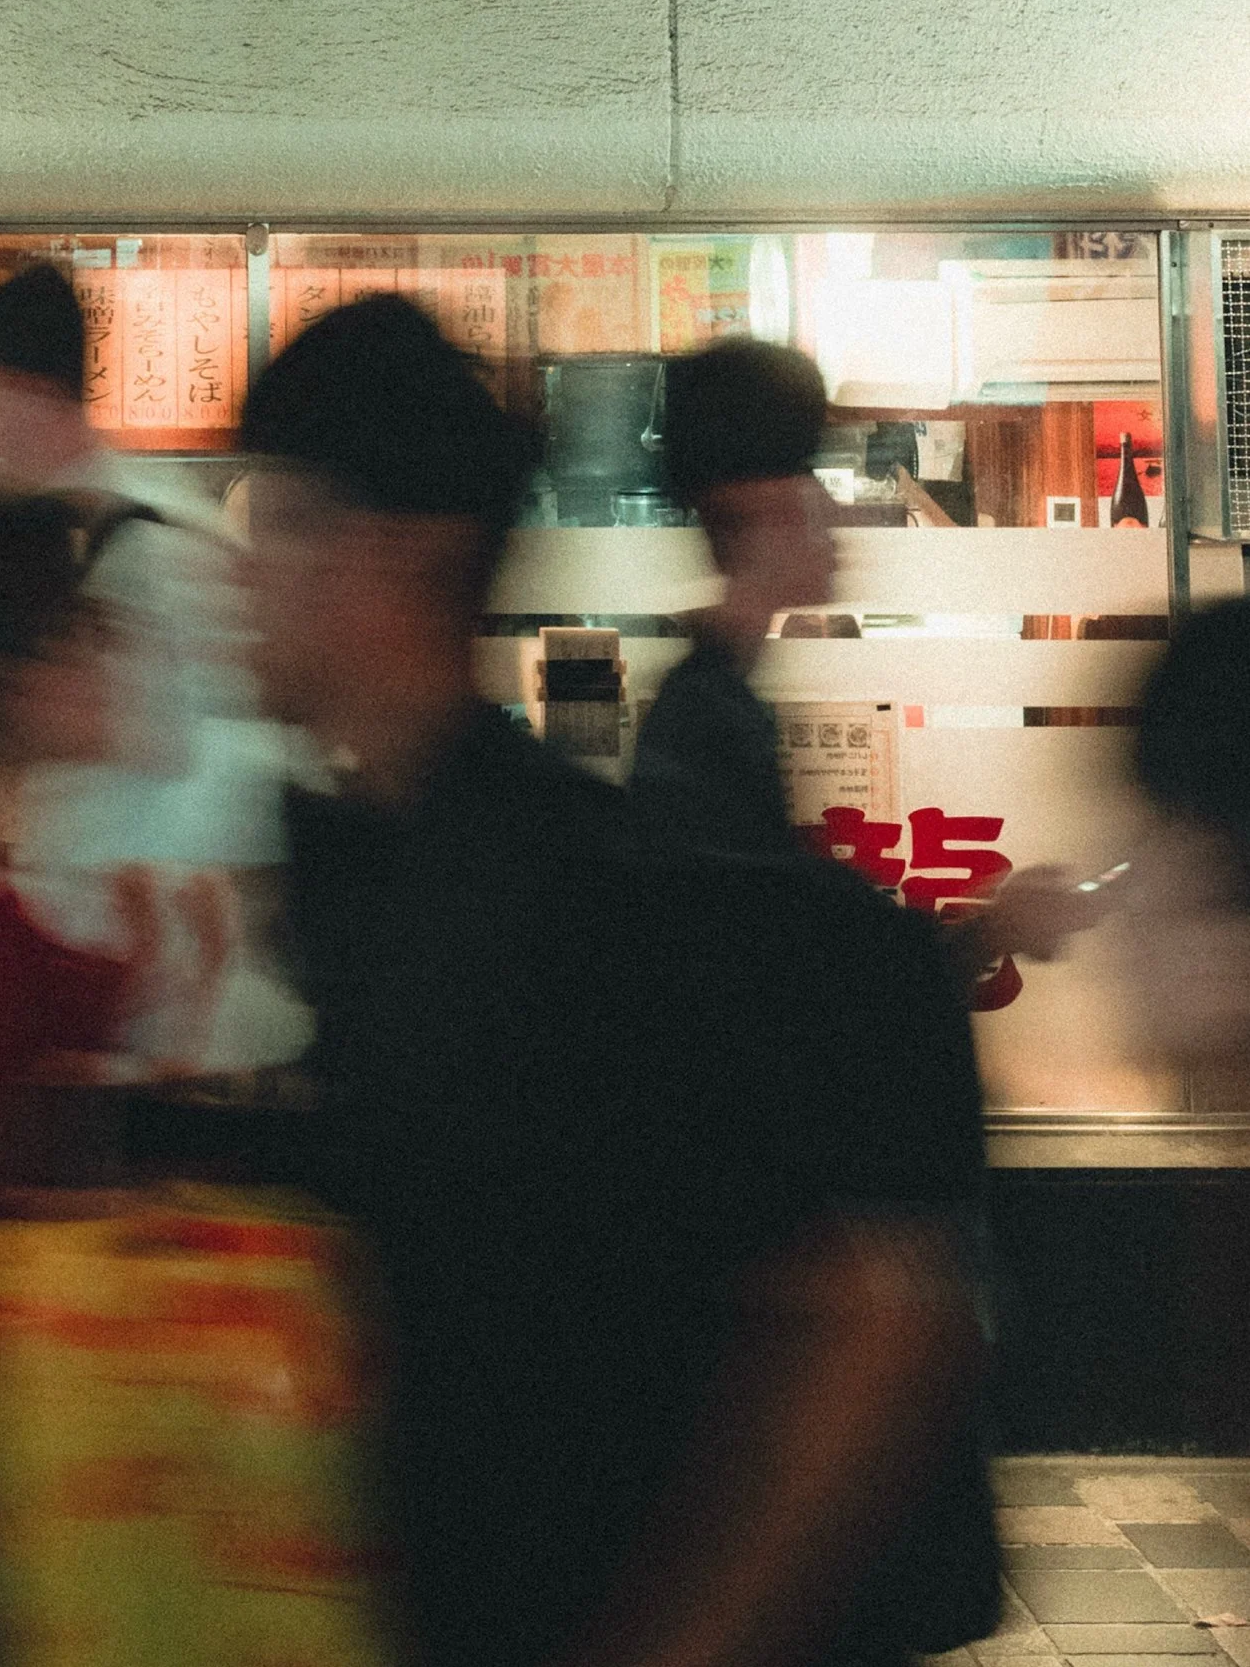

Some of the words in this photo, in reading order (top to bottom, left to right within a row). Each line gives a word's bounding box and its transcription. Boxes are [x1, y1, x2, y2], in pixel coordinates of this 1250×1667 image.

[190, 286, 223, 404] もやしそば
